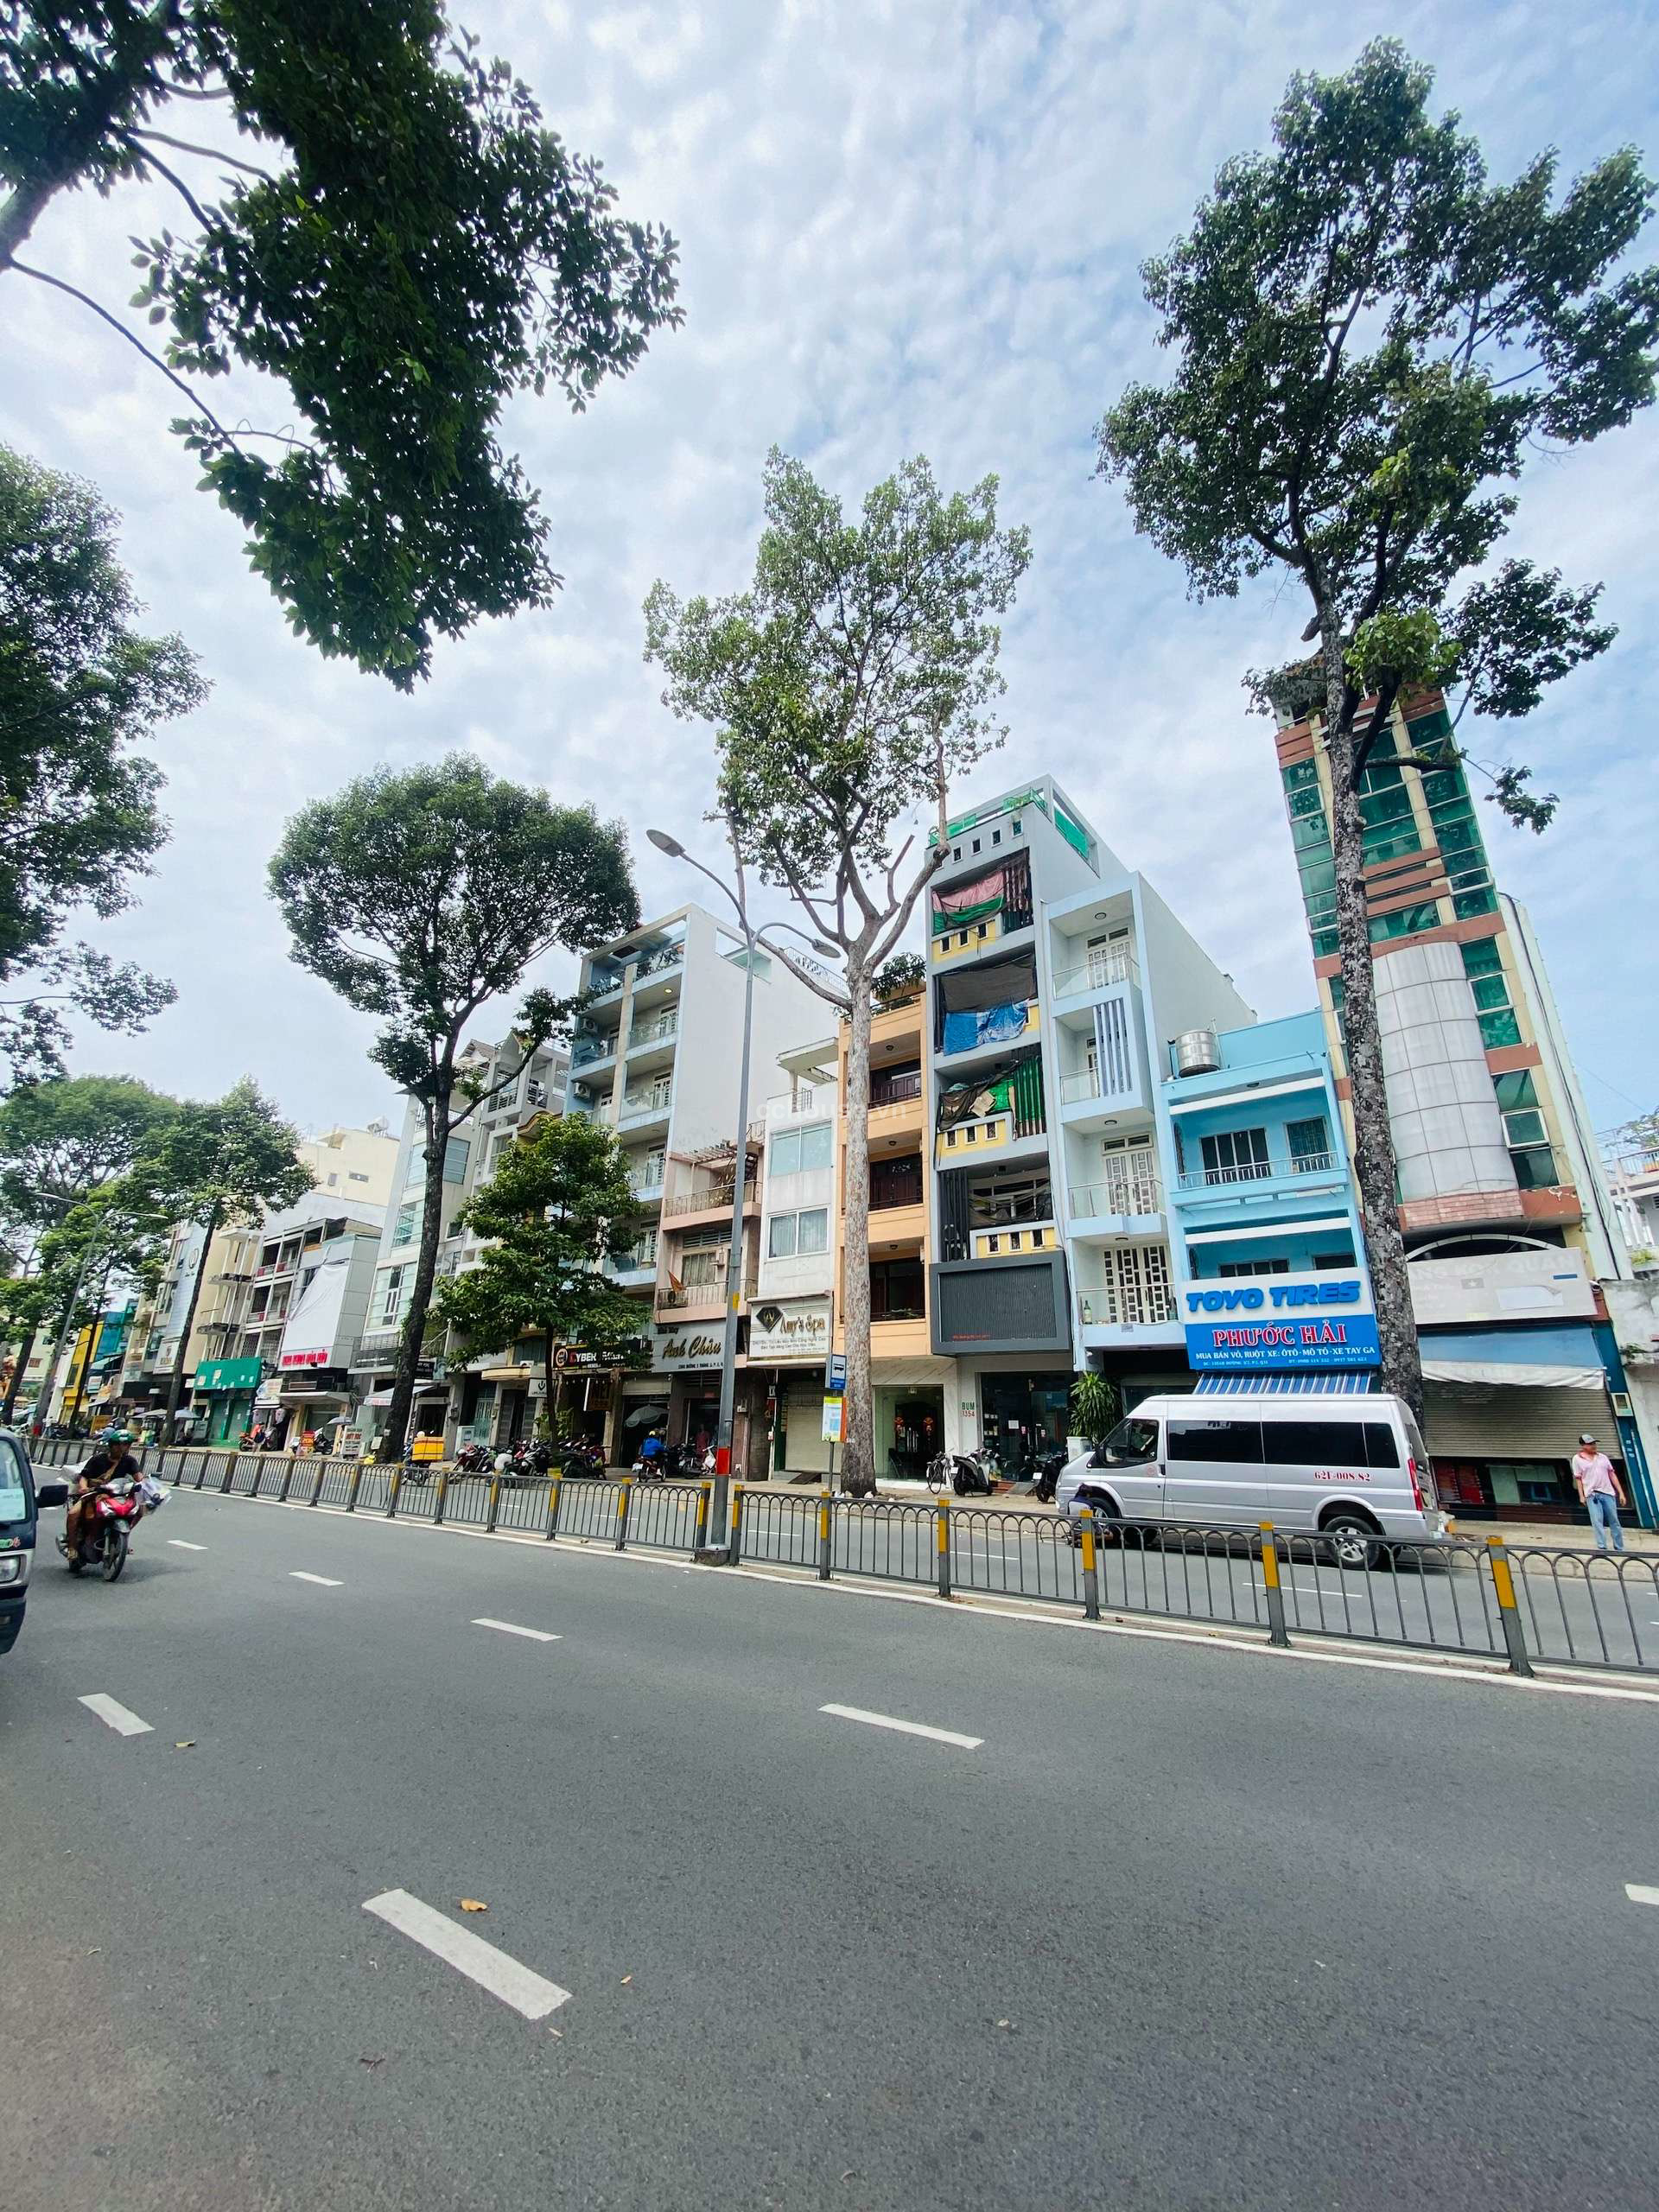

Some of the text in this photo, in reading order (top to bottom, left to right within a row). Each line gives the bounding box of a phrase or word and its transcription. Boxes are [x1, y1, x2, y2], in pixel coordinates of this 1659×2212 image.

[1186, 1281, 1361, 1313] TOYO TIRES
[805, 1314, 825, 1337] Spa
[1212, 1319, 1347, 1347] PHƯỚC HẢI
[1213, 1351, 1229, 1359] BÁN
[1244, 1350, 1265, 1358] RUỘT
